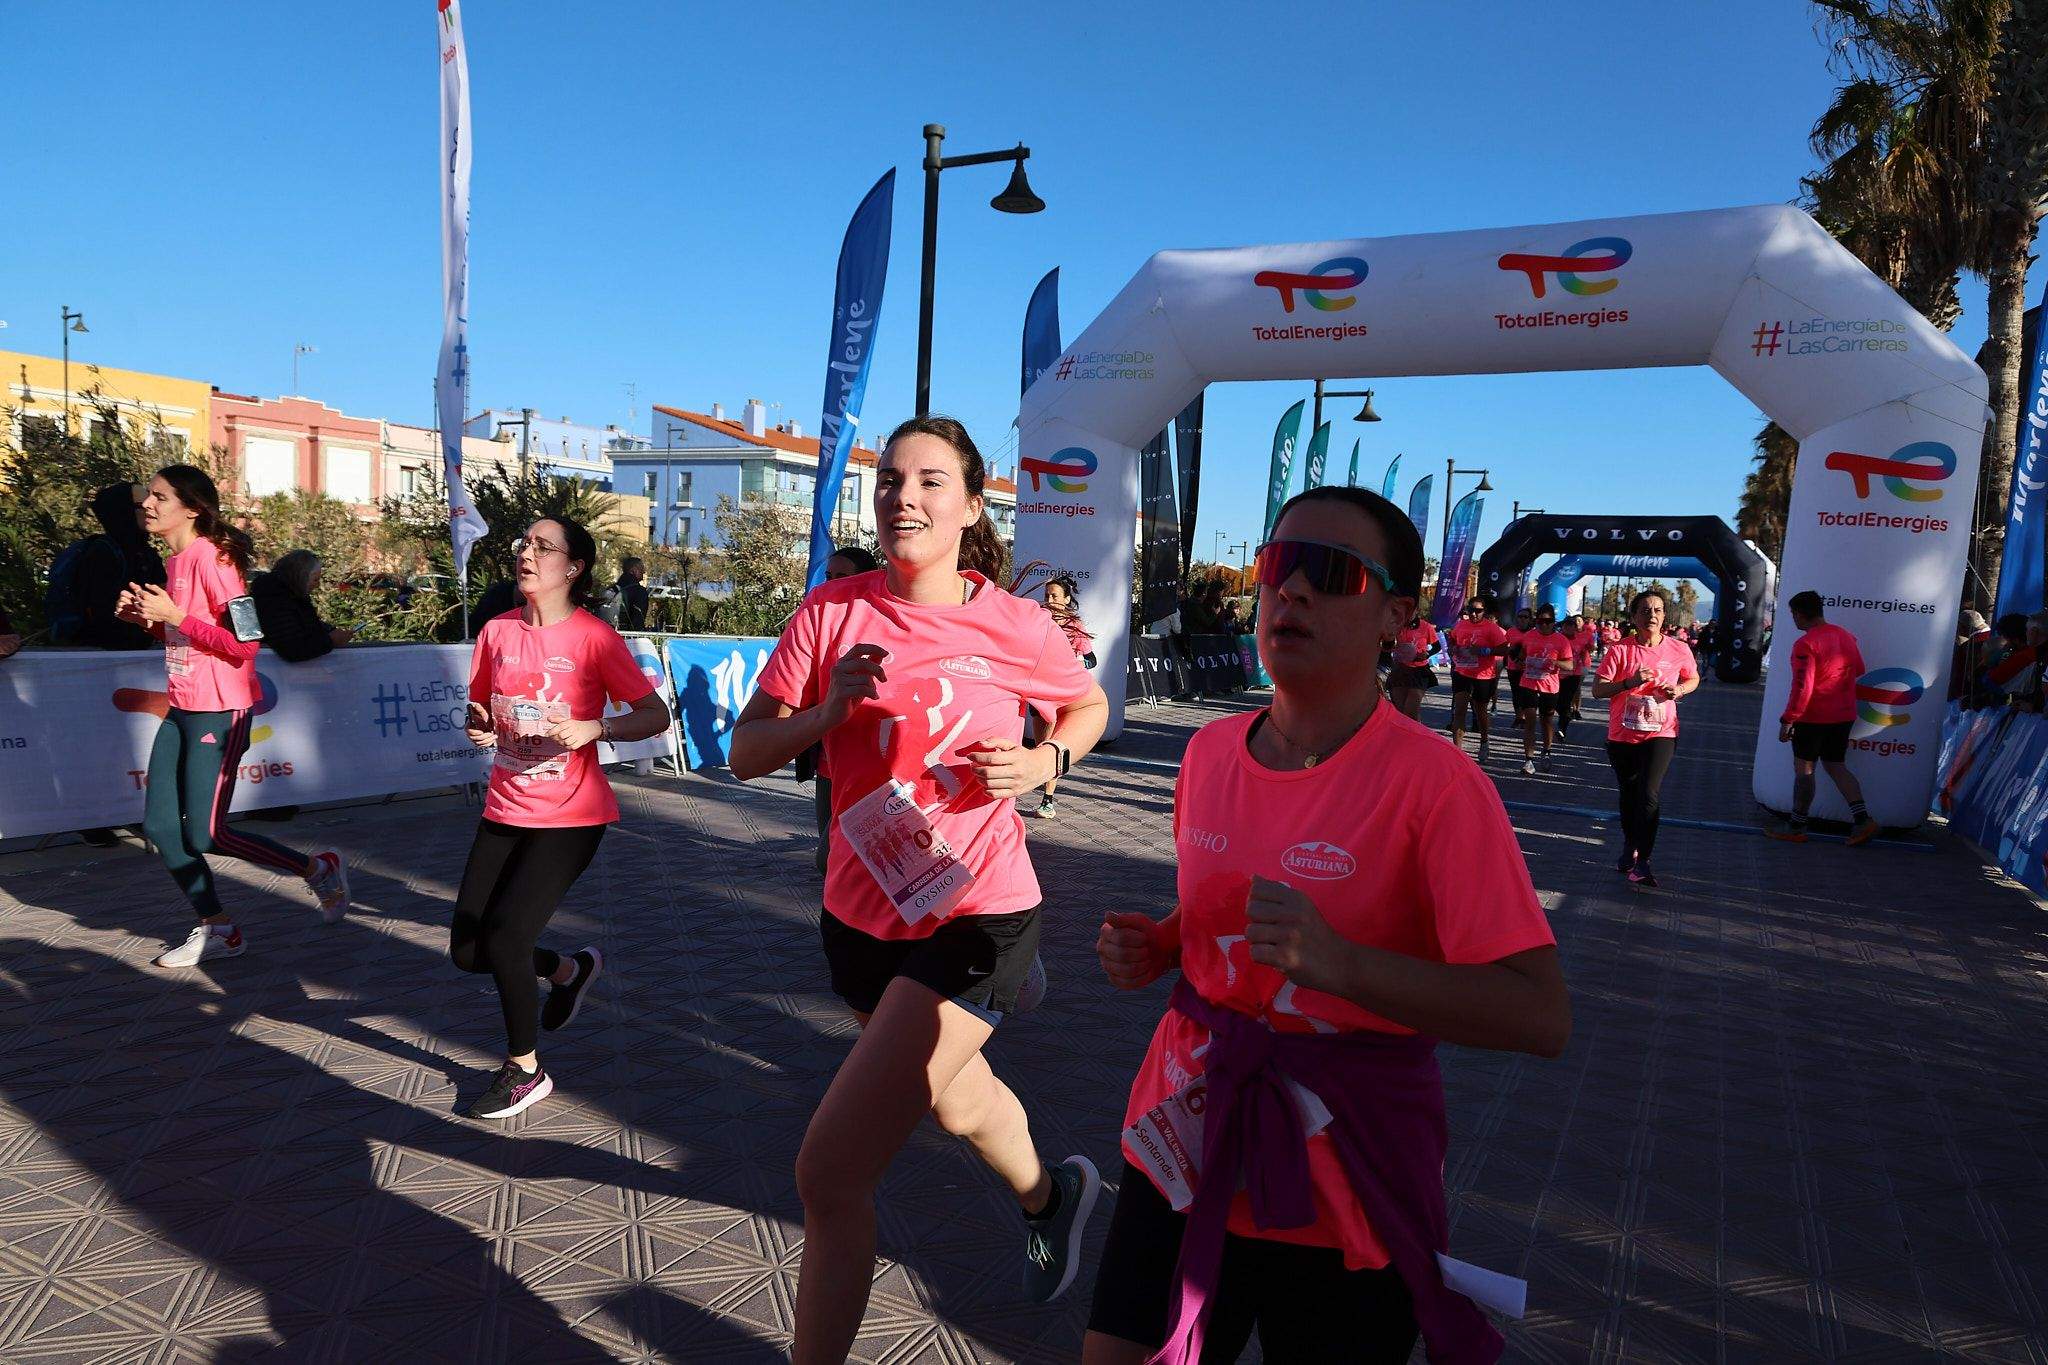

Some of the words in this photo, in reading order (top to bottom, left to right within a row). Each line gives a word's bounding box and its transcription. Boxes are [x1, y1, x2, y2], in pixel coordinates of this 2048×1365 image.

[1495, 307, 1629, 330] TotalEnergies
[1253, 322, 1367, 341] TotalEnergies
[1018, 502, 1095, 518] TotalEnergies
[1817, 511, 1949, 533] TotalEnergies
[1554, 527, 1684, 541] VOLVO
[1611, 554, 1671, 574] Marlene
[1820, 595, 1936, 614] talenergies.es
[1285, 852, 1350, 874] ASTURIANA
[908, 872, 935, 893] CARRERA
[915, 875, 954, 908] OYSHO
[1135, 1128, 1177, 1182] Santander
[1163, 1125, 1188, 1171] VALENCIA
